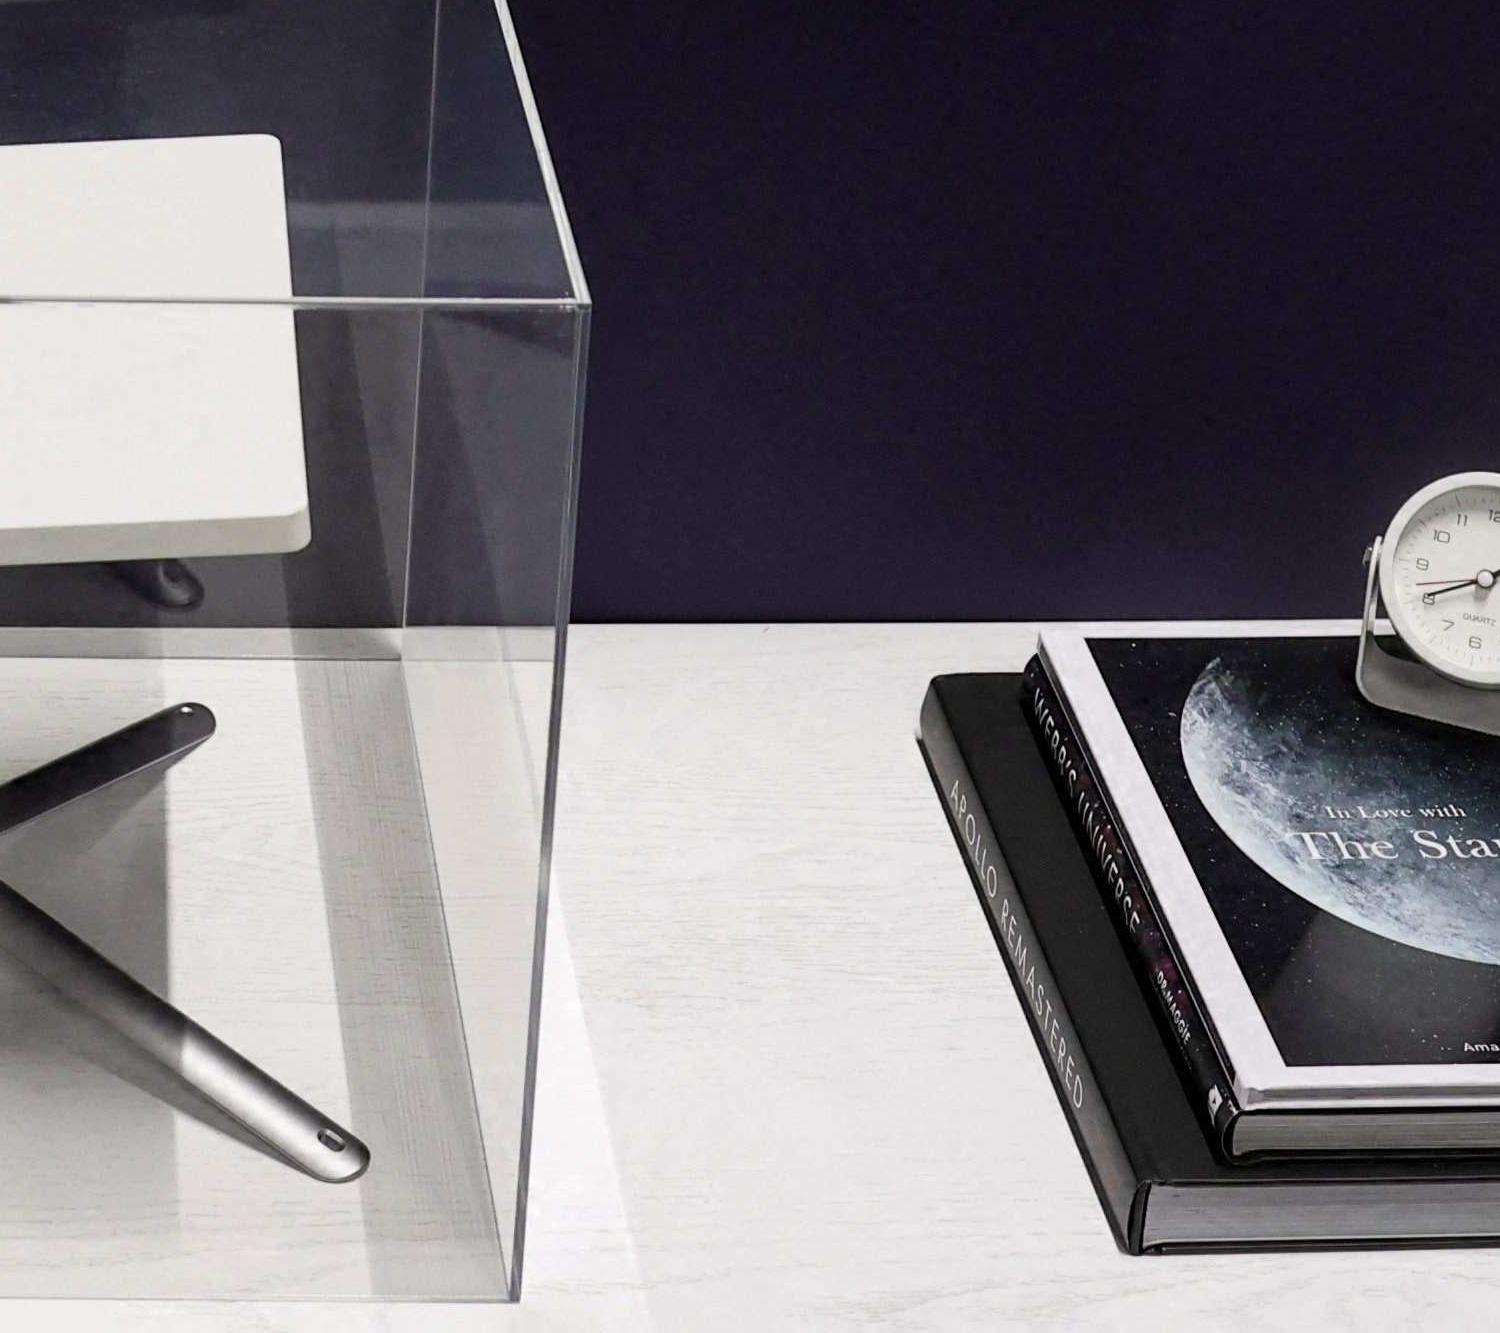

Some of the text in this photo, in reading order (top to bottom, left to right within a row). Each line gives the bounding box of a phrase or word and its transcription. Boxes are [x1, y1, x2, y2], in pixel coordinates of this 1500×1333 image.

[1456, 513, 1468, 526] 11
[1433, 529, 1450, 543] 10
[1416, 558, 1429, 571] 9
[1422, 593, 1436, 606] 8
[1442, 619, 1455, 631] 7
[1462, 612, 1497, 627] QUARTZ
[1468, 637, 1483, 650] 6
[1325, 804, 1467, 819] In Love with
[1300, 831, 1399, 860] The
[951, 780, 1083, 1108] APOLLO REMASTERED
[1165, 990, 1191, 1045] MAGGIE
